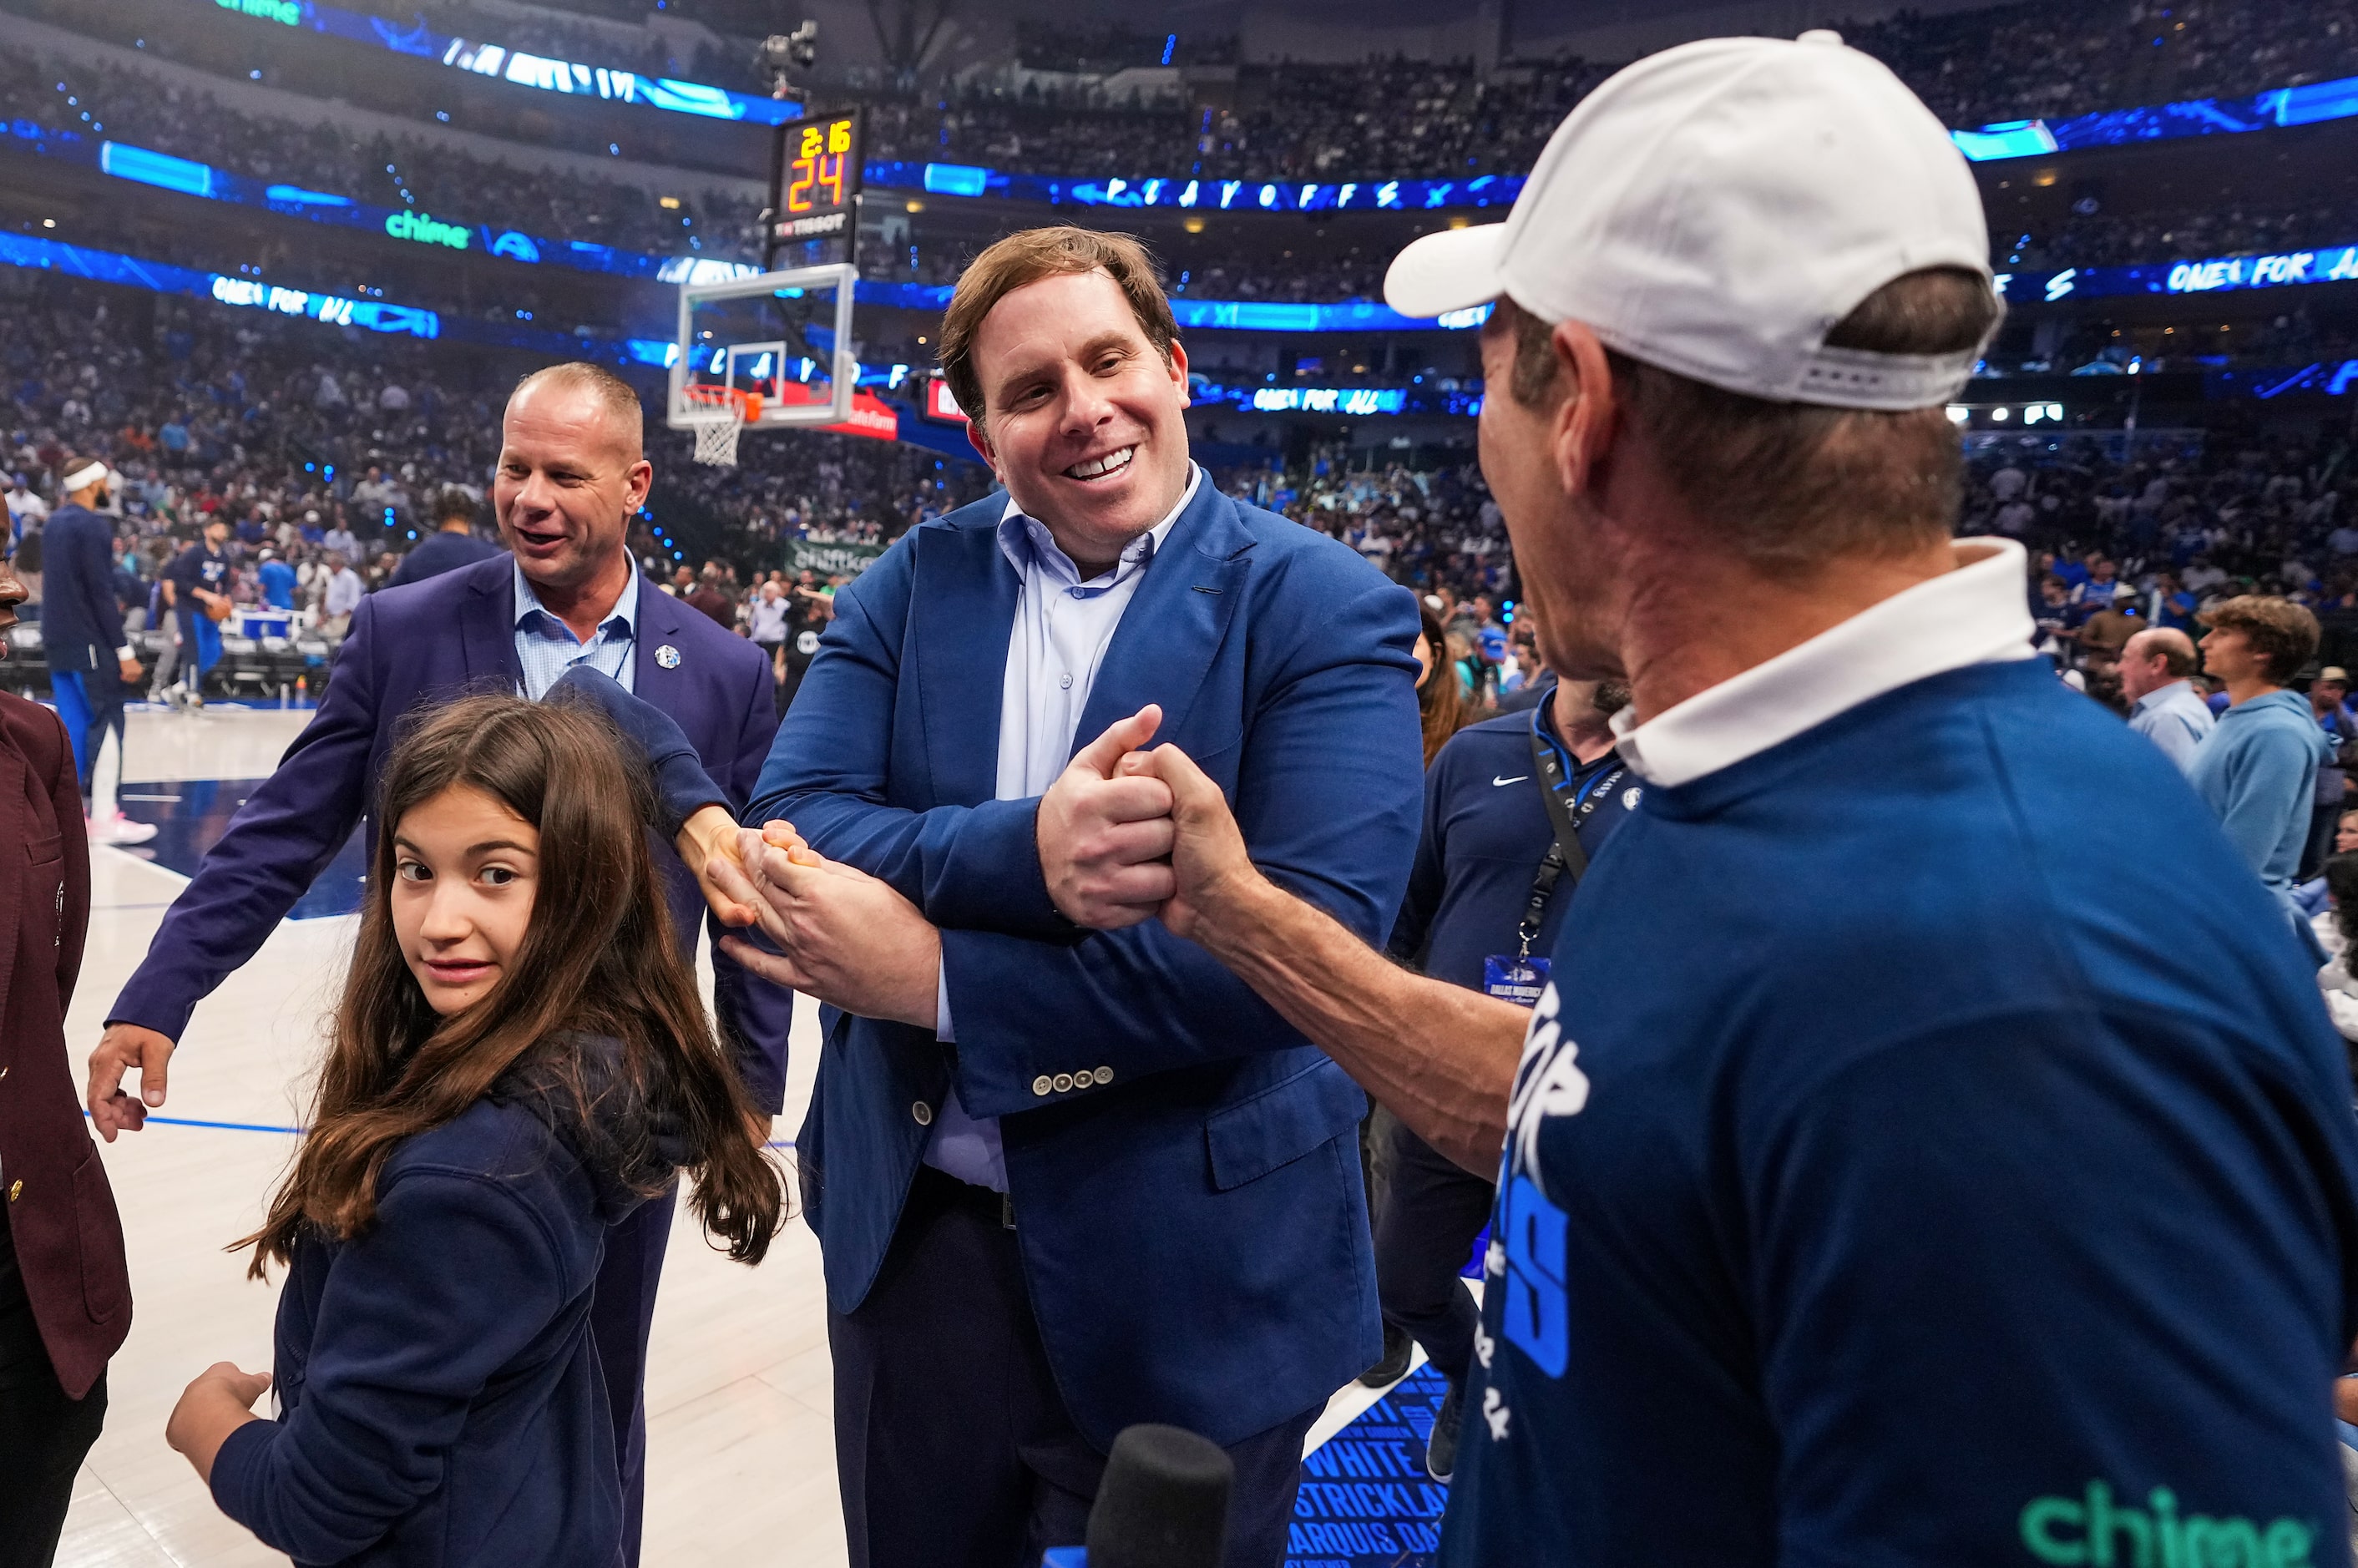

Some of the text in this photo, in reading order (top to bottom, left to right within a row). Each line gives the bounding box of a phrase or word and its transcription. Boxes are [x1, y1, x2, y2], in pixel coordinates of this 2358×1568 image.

[801, 120, 851, 159] 2:16
[788, 152, 844, 213] 24
[385, 209, 468, 250] chime
[2250, 253, 2314, 286] FOR
[267, 286, 308, 315] FOR
[318, 296, 354, 326] ALL
[1301, 388, 1338, 412] FOR
[1303, 1440, 1425, 1477] WHITE
[1286, 1522, 1400, 1558] ARQUIS
[2018, 1479, 2313, 1568] chime
